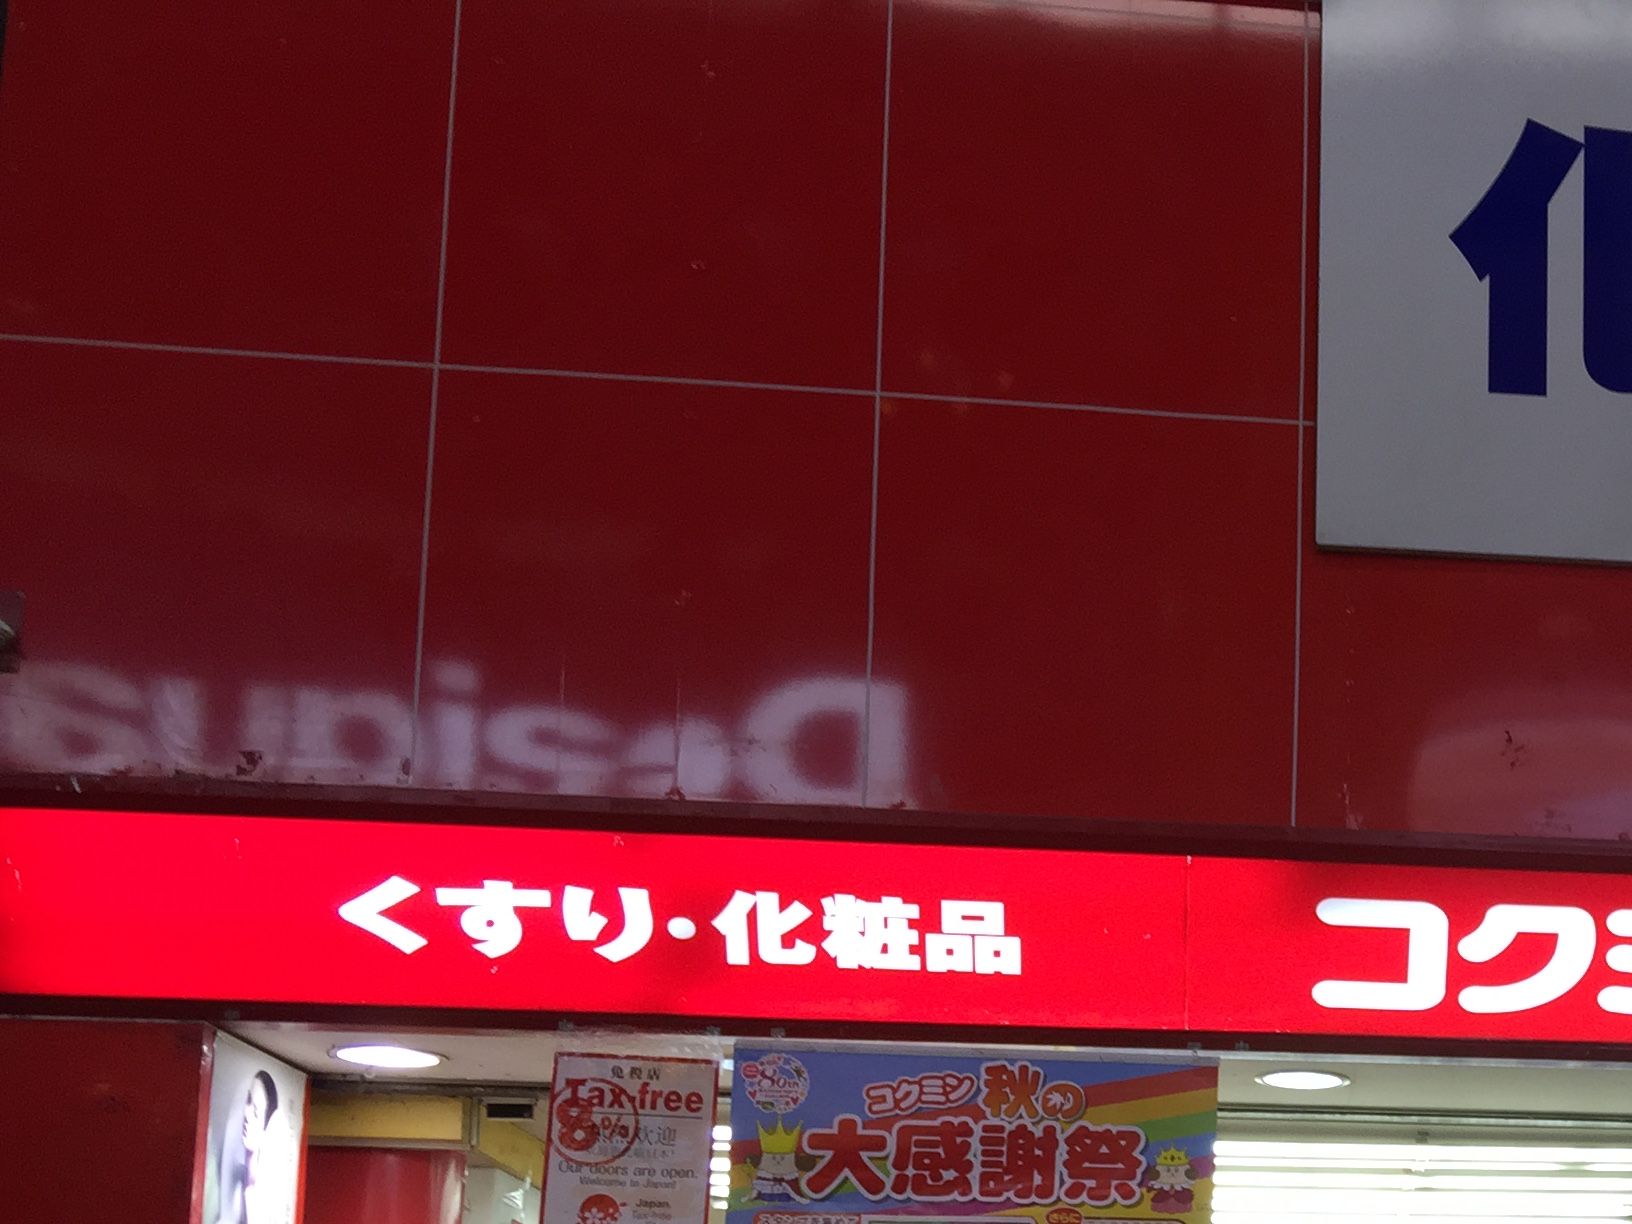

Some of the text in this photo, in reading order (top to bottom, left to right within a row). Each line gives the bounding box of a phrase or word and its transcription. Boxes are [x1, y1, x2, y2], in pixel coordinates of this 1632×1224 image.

[337, 874, 1022, 976] くすり・化粧品
[803, 1118, 1144, 1203] 大感謝祭
